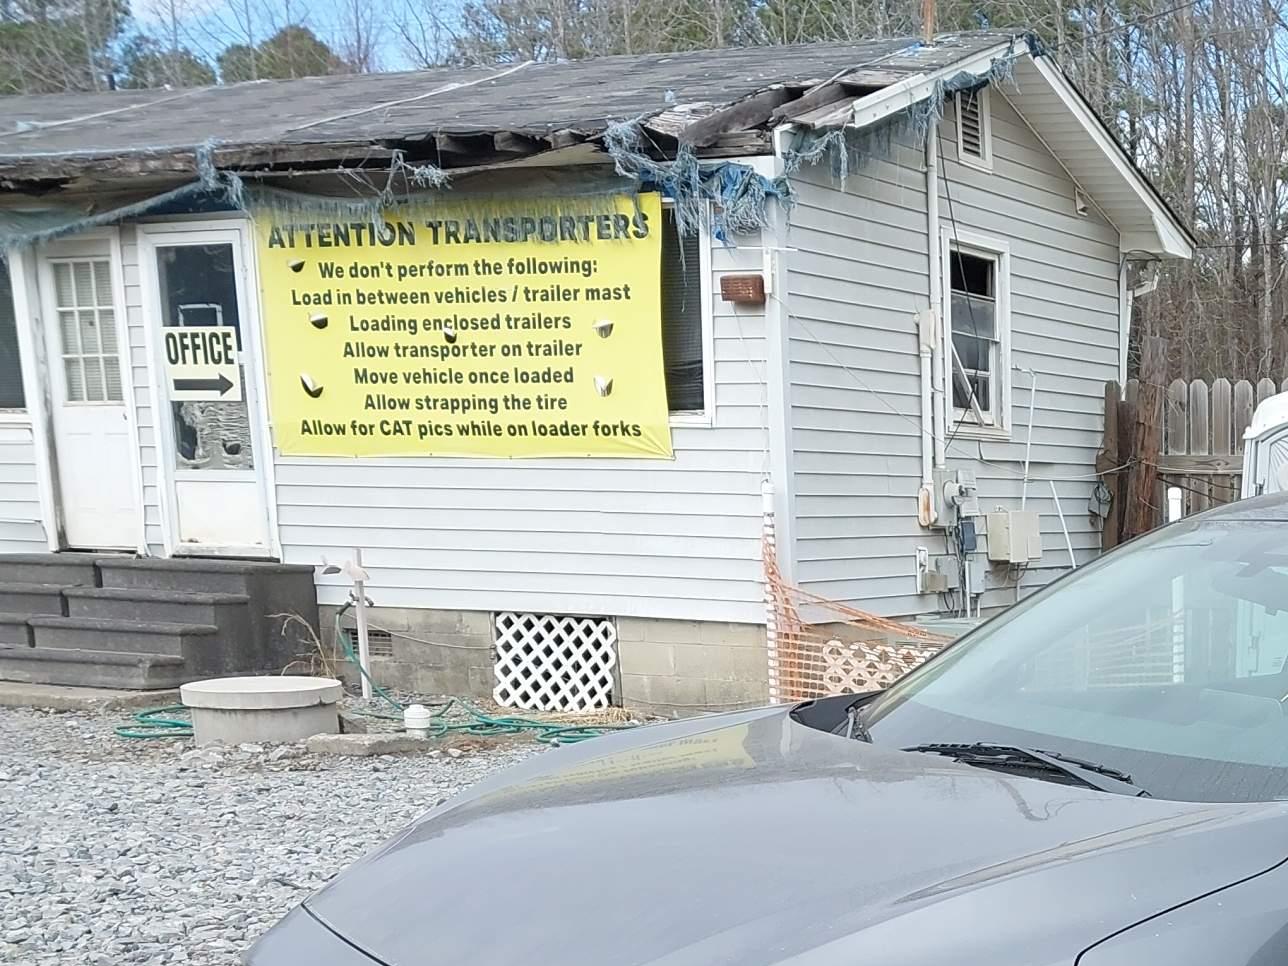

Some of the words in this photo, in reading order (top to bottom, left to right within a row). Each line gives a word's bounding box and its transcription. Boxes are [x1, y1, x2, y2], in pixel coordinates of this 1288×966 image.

[268, 221, 416, 248] ATTENTION
[426, 213, 650, 244] TRANSPORTERS
[318, 261, 345, 279] We
[350, 261, 393, 279] don't
[398, 260, 469, 281] perform
[473, 258, 503, 275] the
[507, 257, 598, 278] following:
[291, 289, 332, 305] Load
[337, 289, 351, 305] in
[356, 288, 430, 305] between
[434, 286, 508, 304] vehicles
[511, 285, 519, 302] /
[523, 284, 580, 301] trailer
[585, 284, 631, 300] mast
[349, 315, 418, 335] Loading
[422, 313, 500, 331] enclosed
[505, 312, 572, 329] trailers
[165, 331, 235, 365] OFFICE
[343, 341, 389, 358] Allow
[393, 341, 496, 361] transporter
[500, 343, 522, 357] on
[526, 340, 583, 356] trailer
[353, 368, 399, 384] Move
[402, 367, 464, 384] vehicle
[468, 370, 510, 383] once
[514, 366, 574, 383] loaded
[364, 394, 410, 410] Allow
[415, 394, 498, 415] strapping
[502, 394, 532, 410] the
[536, 394, 568, 410] tire
[301, 419, 346, 435] Allow
[350, 420, 376, 436] for
[379, 420, 413, 436] CAT
[417, 420, 453, 439] pics
[456, 420, 503, 436] while
[507, 423, 528, 436] on
[531, 420, 588, 436] loader
[592, 420, 642, 436] forks
